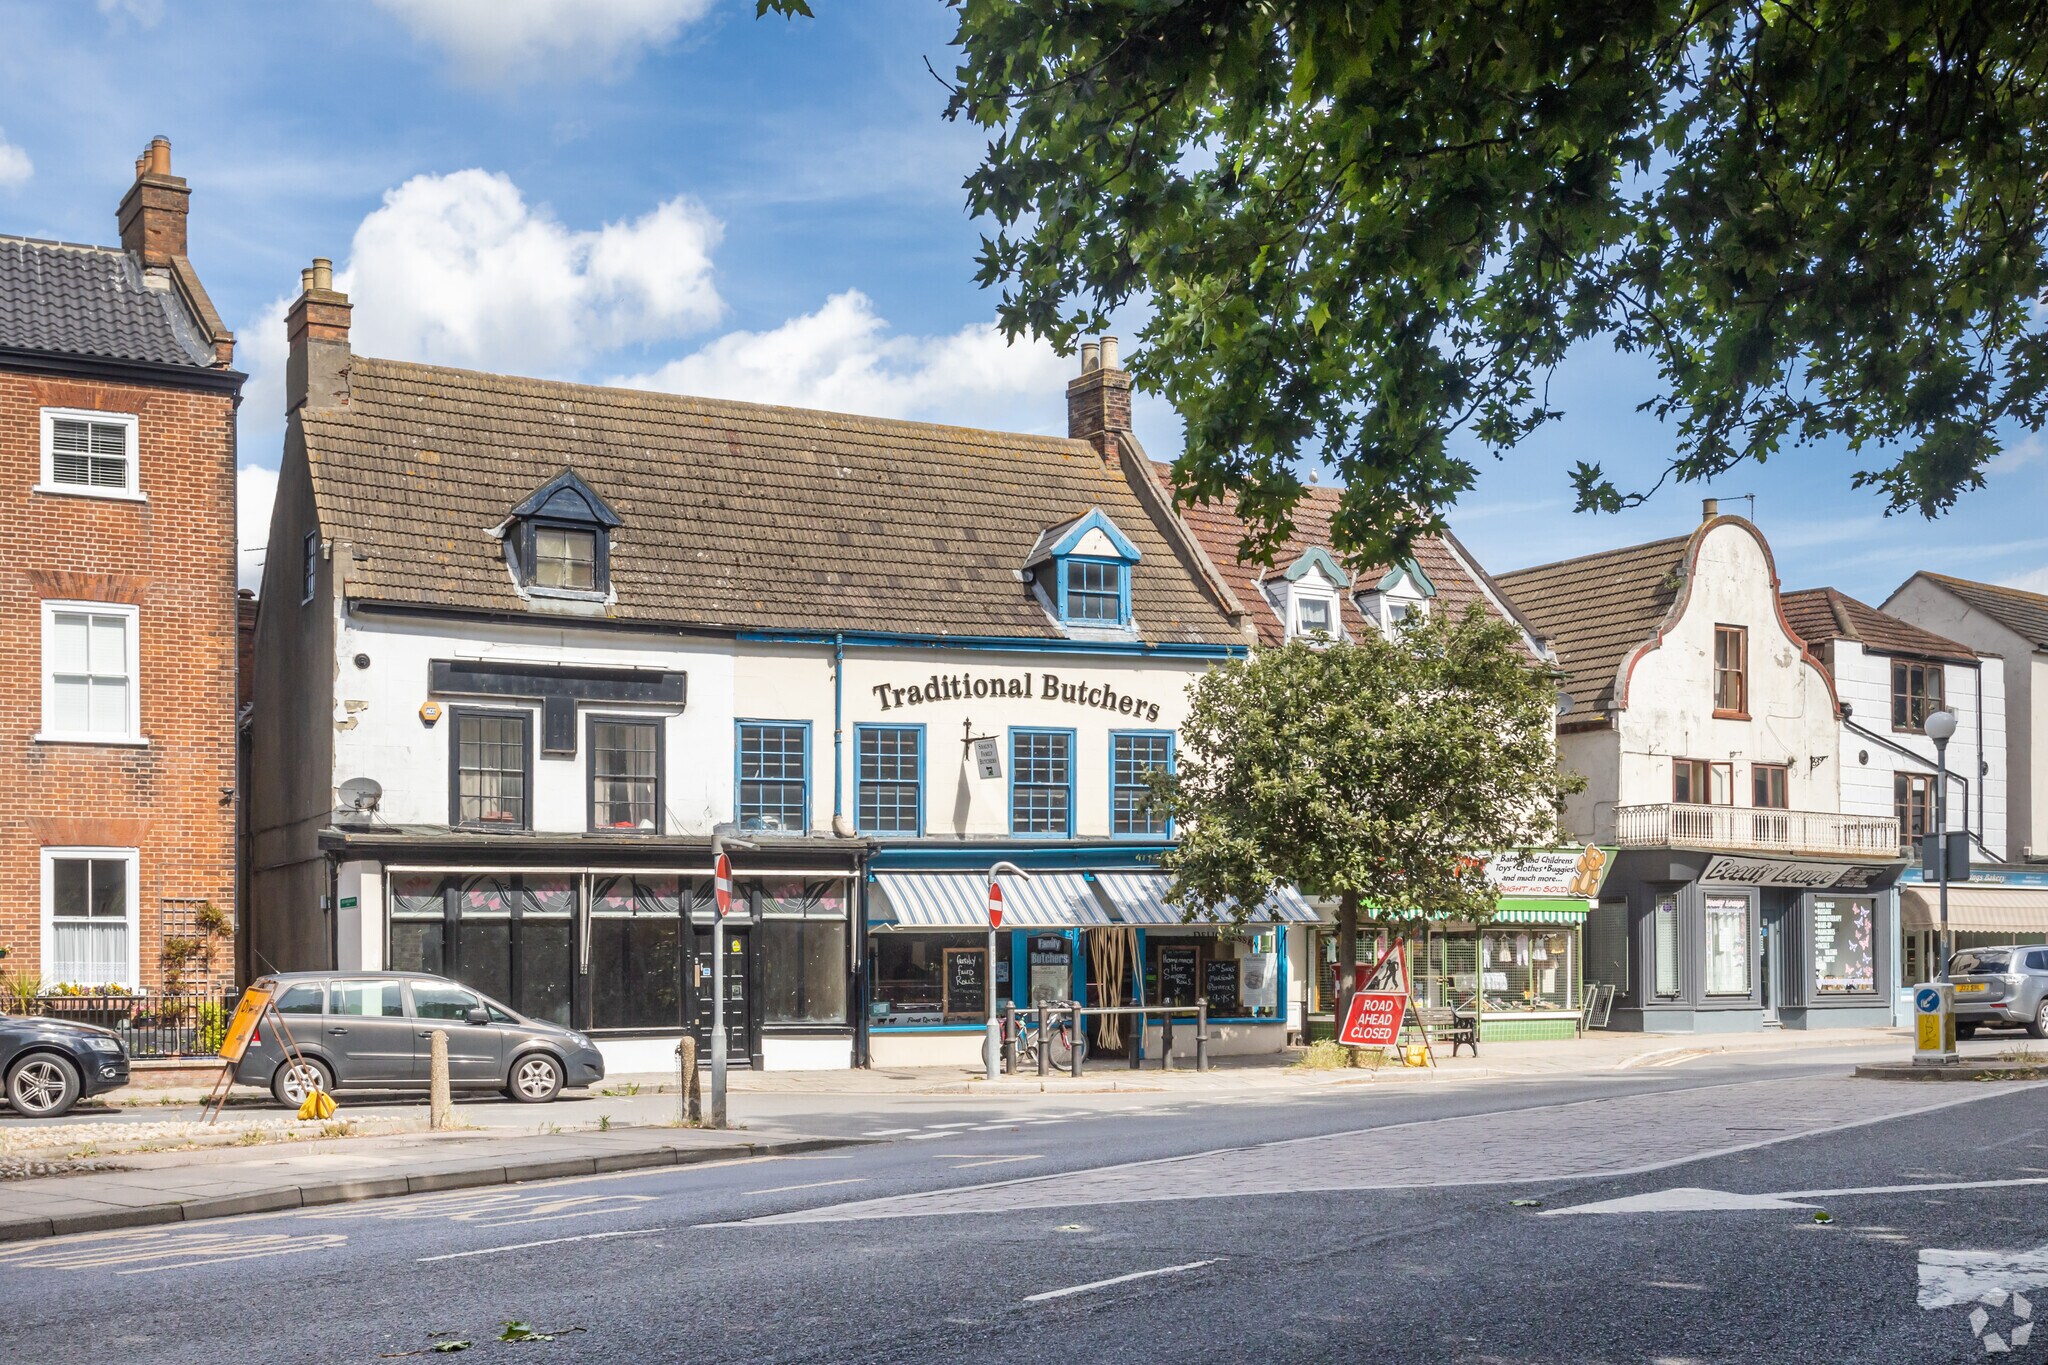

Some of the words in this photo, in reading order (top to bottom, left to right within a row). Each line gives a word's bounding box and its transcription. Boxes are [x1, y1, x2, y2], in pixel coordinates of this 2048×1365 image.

[872, 672, 1034, 711] Traditional
[1040, 673, 1160, 723] Butchers
[1541, 856, 1574, 864] Childrens
[1495, 864, 1512, 874] Toys
[1547, 865, 1575, 875] Buggies
[1705, 858, 1778, 883] Beauty
[1771, 863, 1839, 886] Lounge
[1501, 874, 1516, 882] and
[1517, 874, 1536, 882] much
[1984, 874, 2005, 883] Bakery
[1543, 885, 1568, 893] SOLD
[1038, 937, 1061, 951] Family
[1031, 952, 1069, 964] Butchers
[1363, 1000, 1394, 1012] ROAD
[1357, 1013, 1393, 1025] AHEAD
[1350, 1027, 1392, 1039] CLOSED
